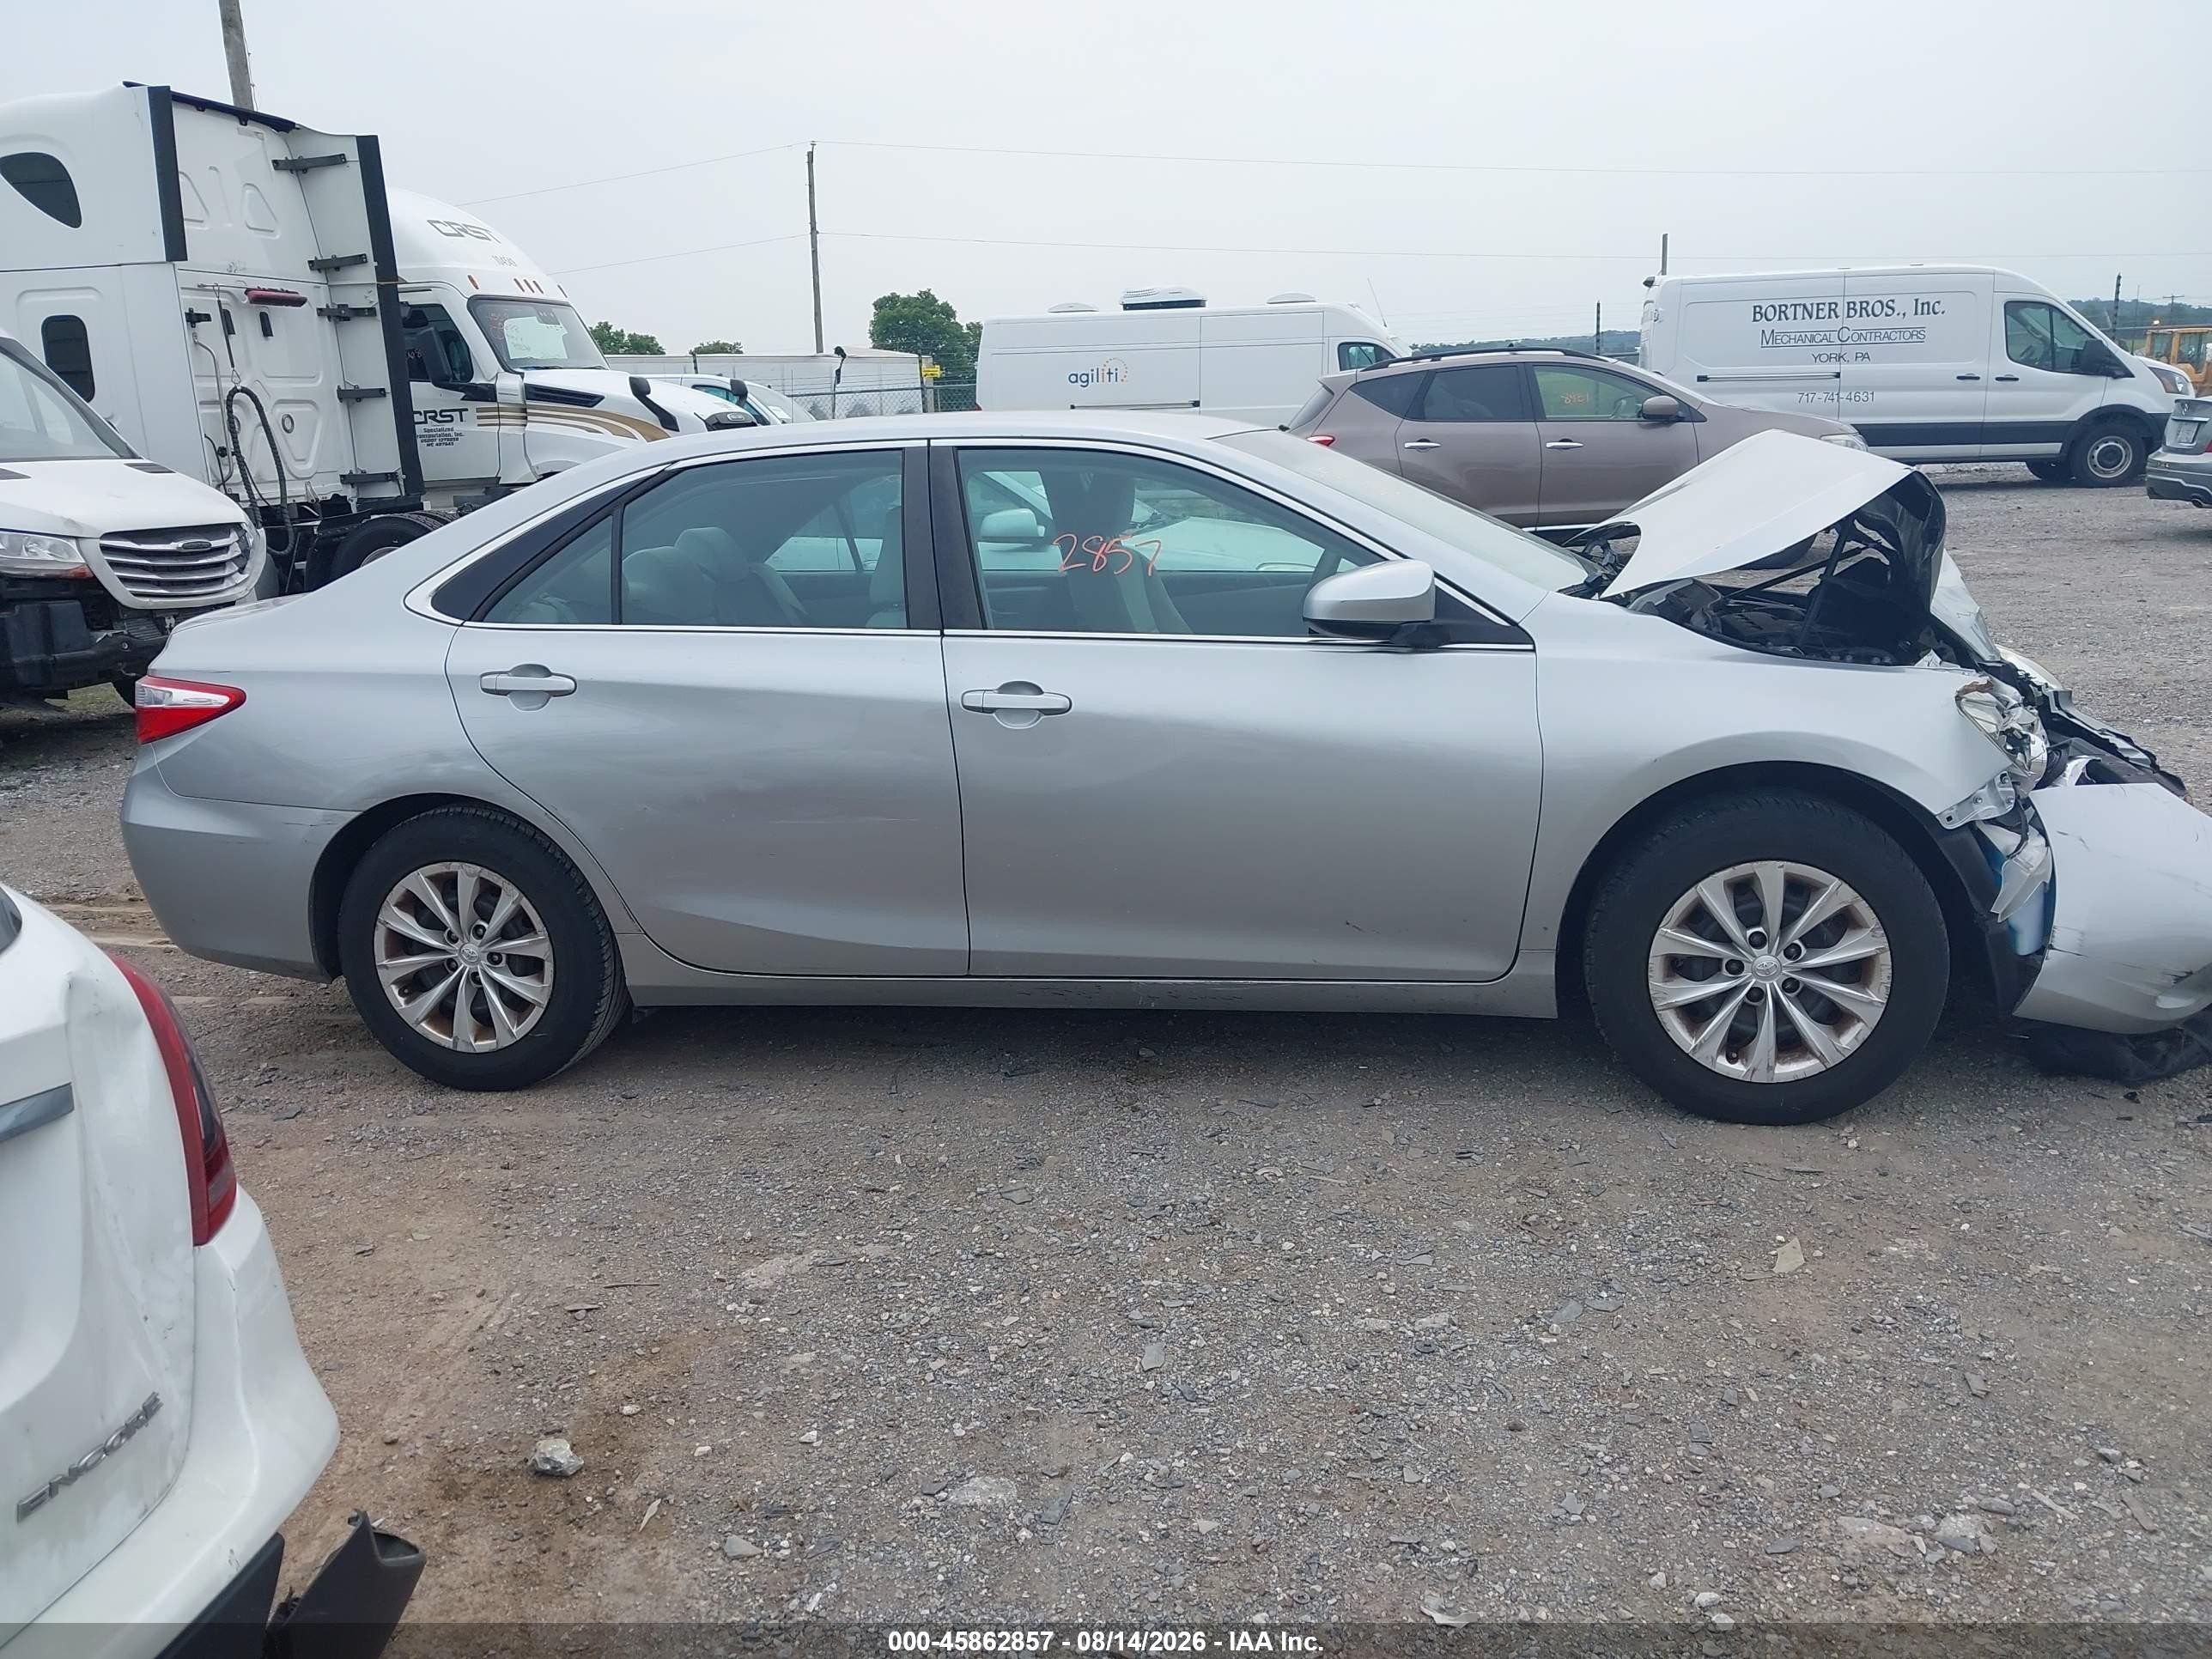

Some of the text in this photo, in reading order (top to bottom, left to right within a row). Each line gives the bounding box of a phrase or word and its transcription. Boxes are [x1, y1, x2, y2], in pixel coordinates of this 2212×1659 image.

[427, 220, 501, 244] CRST
[1752, 298, 1946, 323] BORTNER BROS., Inc.
[1812, 352, 1871, 363] YORK, PA
[1067, 367, 1119, 388] agiliti
[1797, 391, 1875, 404] 717-741-4631
[412, 408, 468, 425] CRST
[1053, 533, 1162, 577] 2857
[16, 1391, 164, 1523] ENCORE
